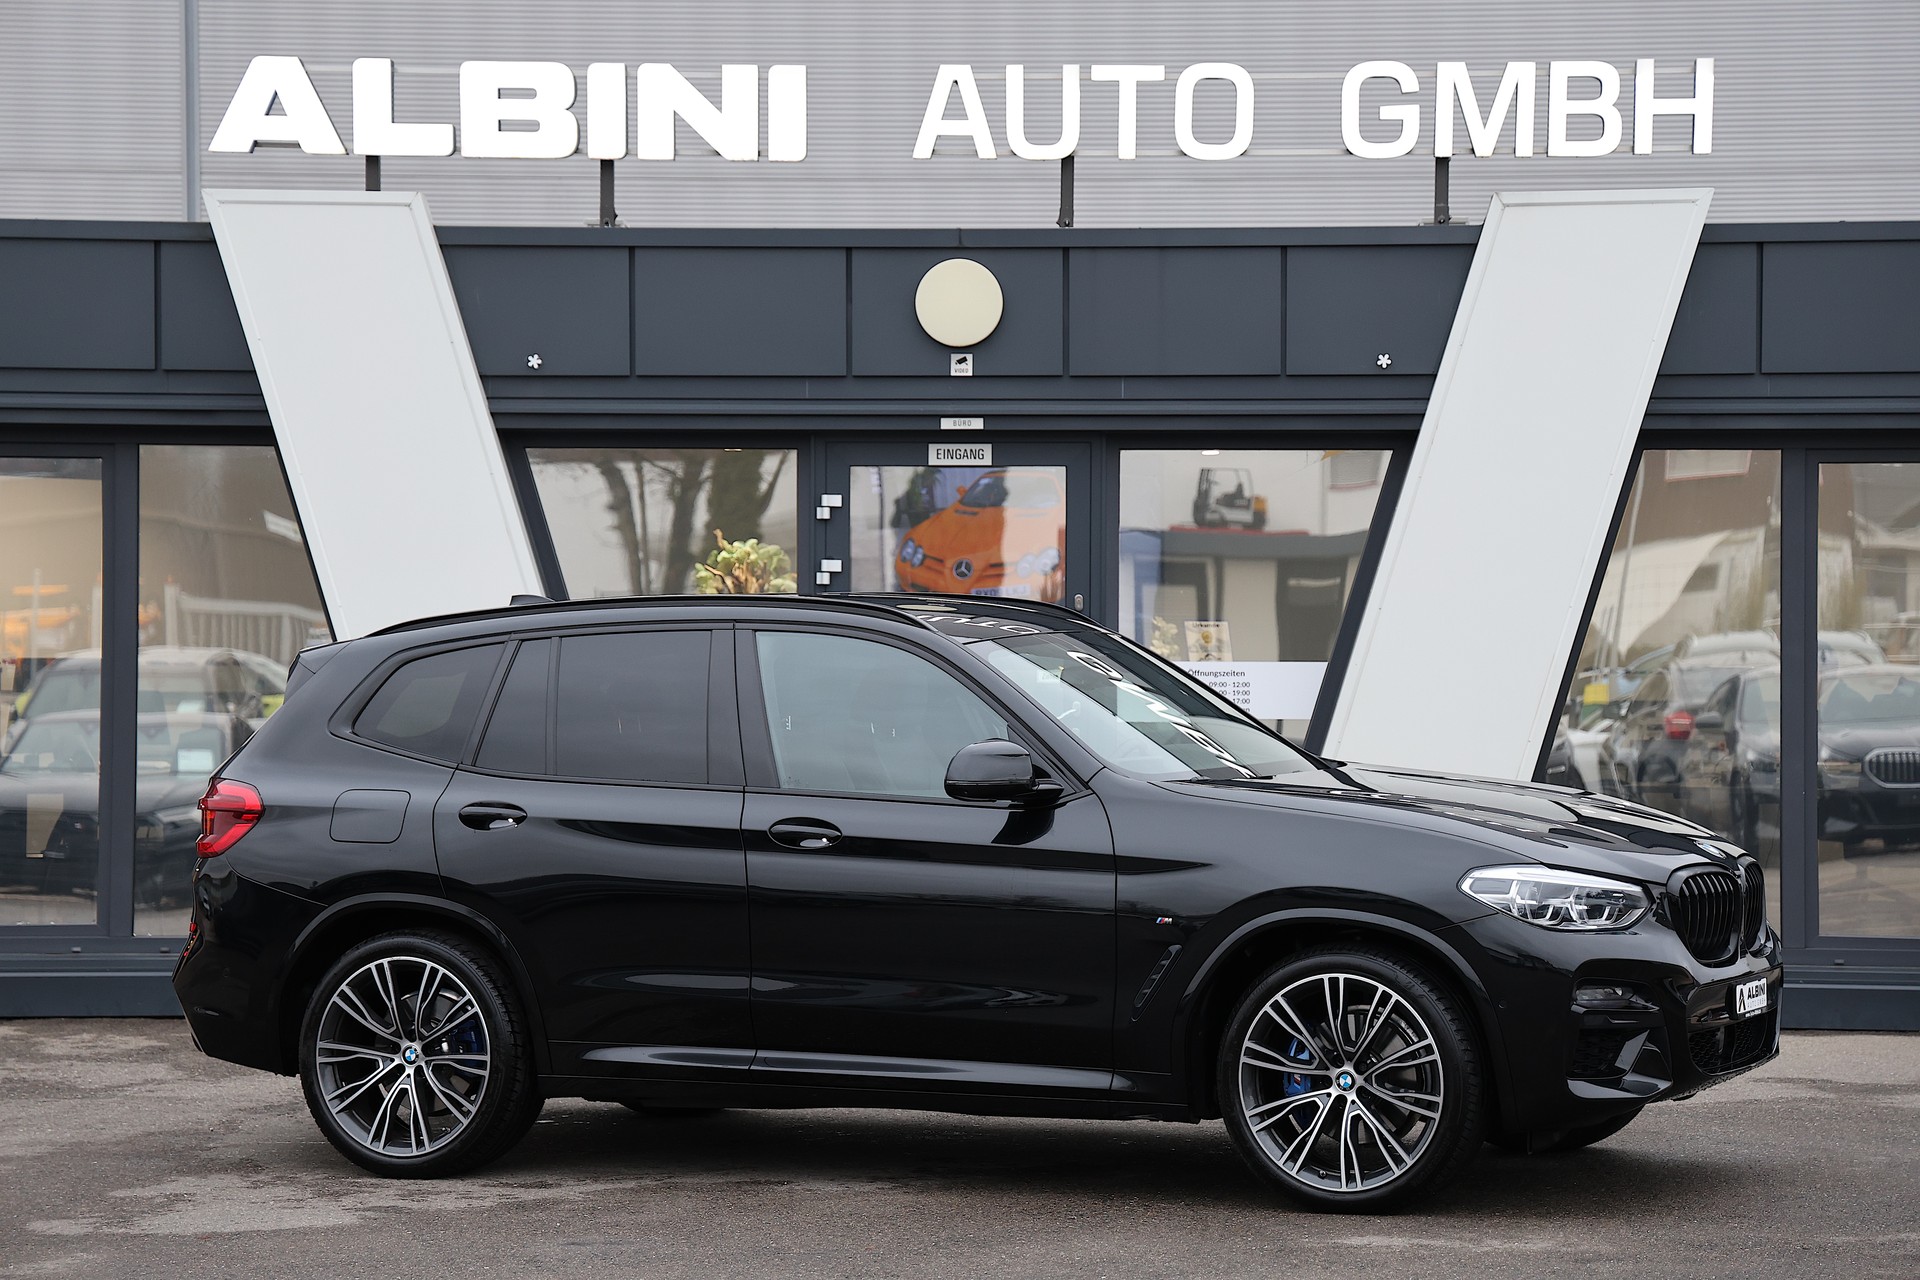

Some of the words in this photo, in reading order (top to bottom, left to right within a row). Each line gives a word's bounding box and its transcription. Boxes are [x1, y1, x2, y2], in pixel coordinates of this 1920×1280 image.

[207, 55, 808, 162] ALBINI
[912, 62, 1255, 160] AUTO
[1341, 57, 1715, 158] GMBH
[936, 448, 985, 460] EINGANG
[1188, 669, 1246, 678] Öffnungszeiten
